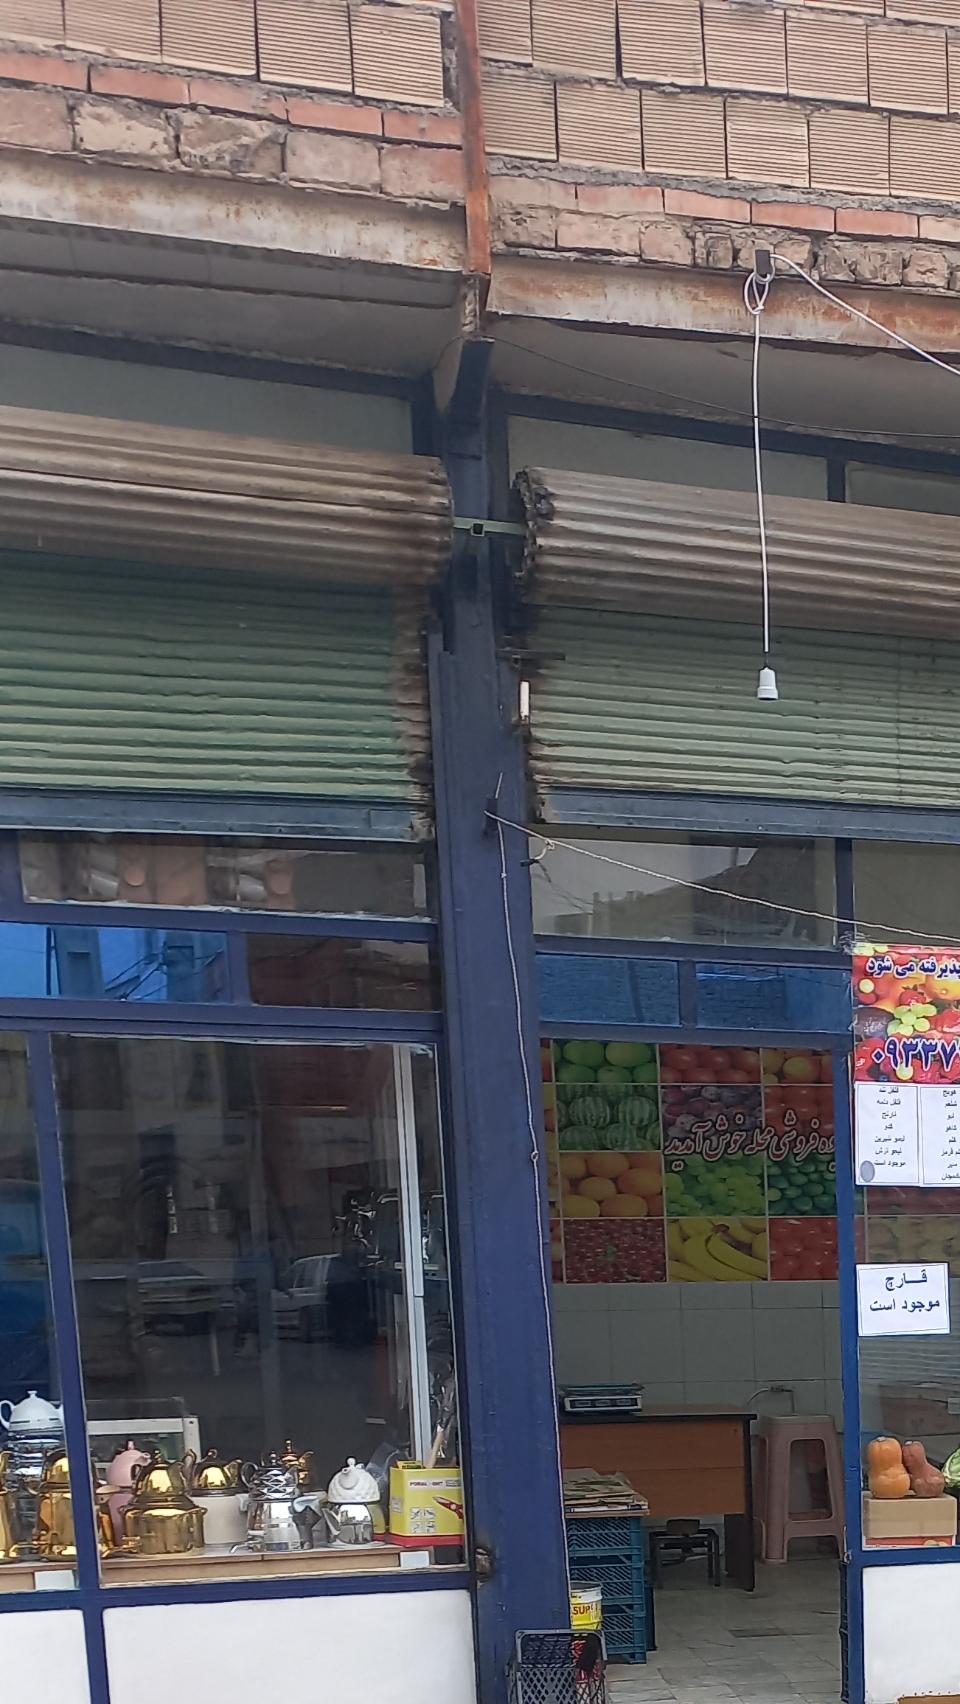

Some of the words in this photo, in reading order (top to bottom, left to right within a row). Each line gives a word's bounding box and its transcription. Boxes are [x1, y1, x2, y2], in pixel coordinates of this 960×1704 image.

[866, 957, 893, 976] شود
[894, 960, 915, 978] می
[703, 1114, 747, 1161] خوش
[769, 1110, 820, 1161] فروشی
[885, 1268, 928, 1291] قارچ
[869, 1298, 896, 1312] است
[901, 1299, 940, 1313] موجود
